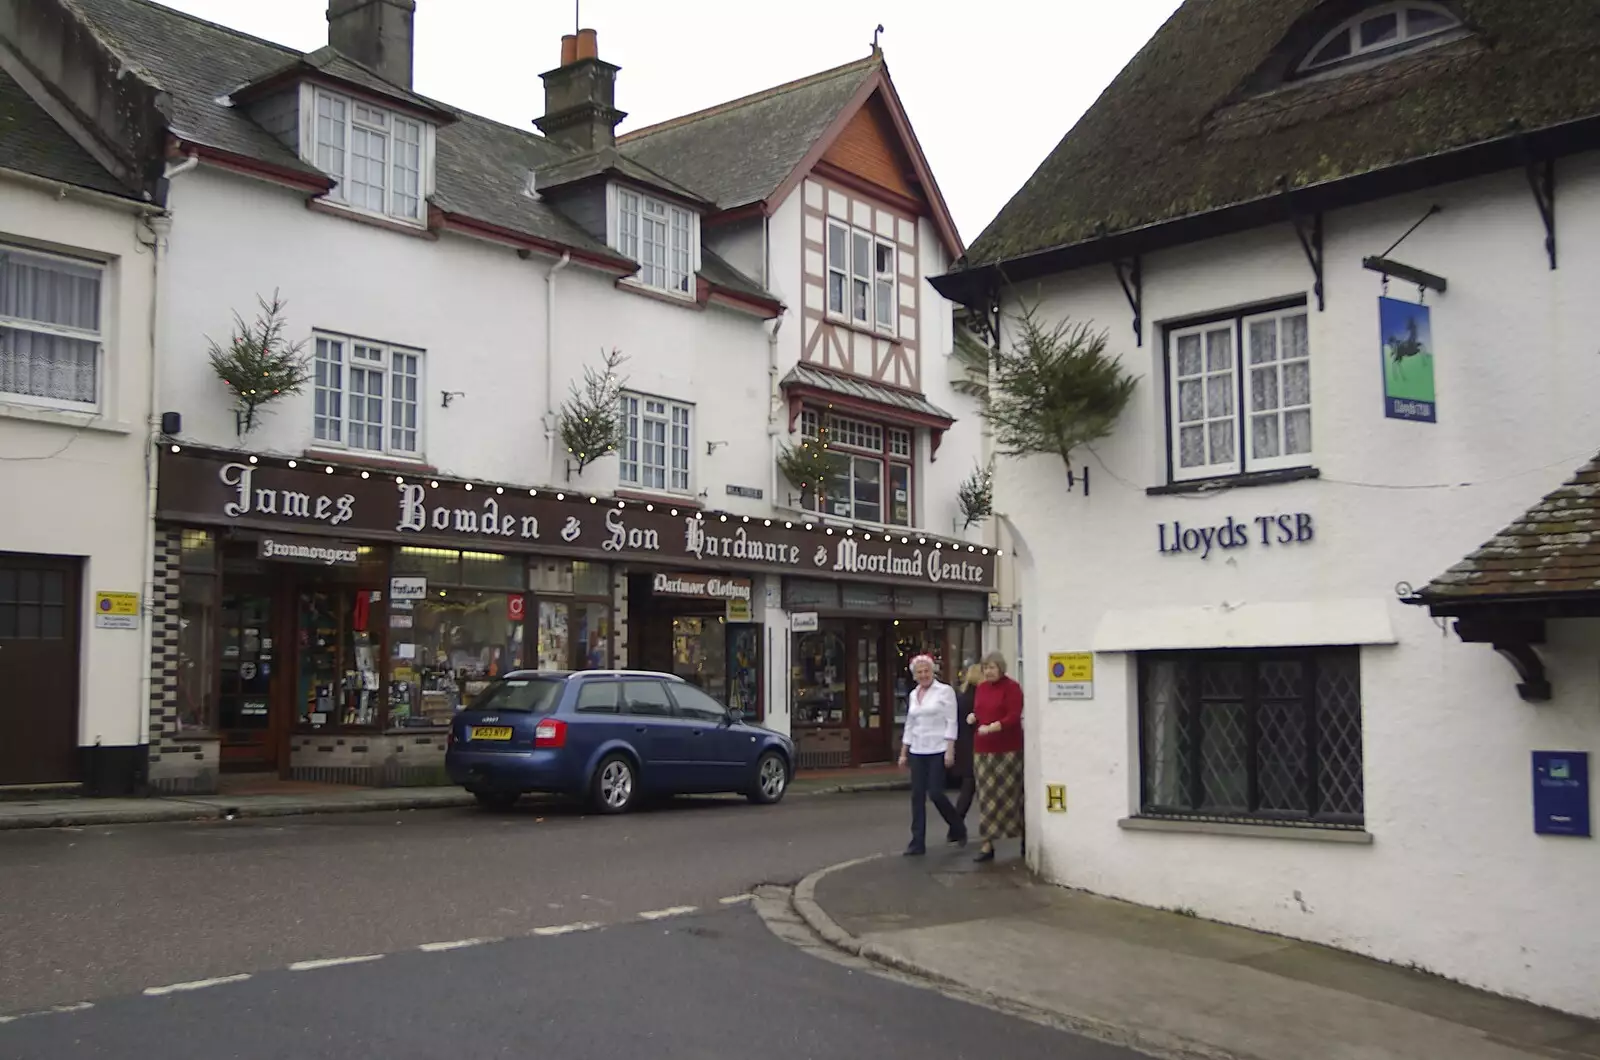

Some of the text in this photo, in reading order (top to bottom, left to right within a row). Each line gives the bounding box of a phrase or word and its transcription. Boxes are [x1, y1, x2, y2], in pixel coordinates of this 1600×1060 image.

[218, 462, 984, 582] James Bowden & Son Hardware & Moorland Centre
[1157, 513, 1314, 560] Lloyds TSB
[263, 539, 358, 565] Ironmongers
[653, 573, 750, 600] Dartmoor Clothing
